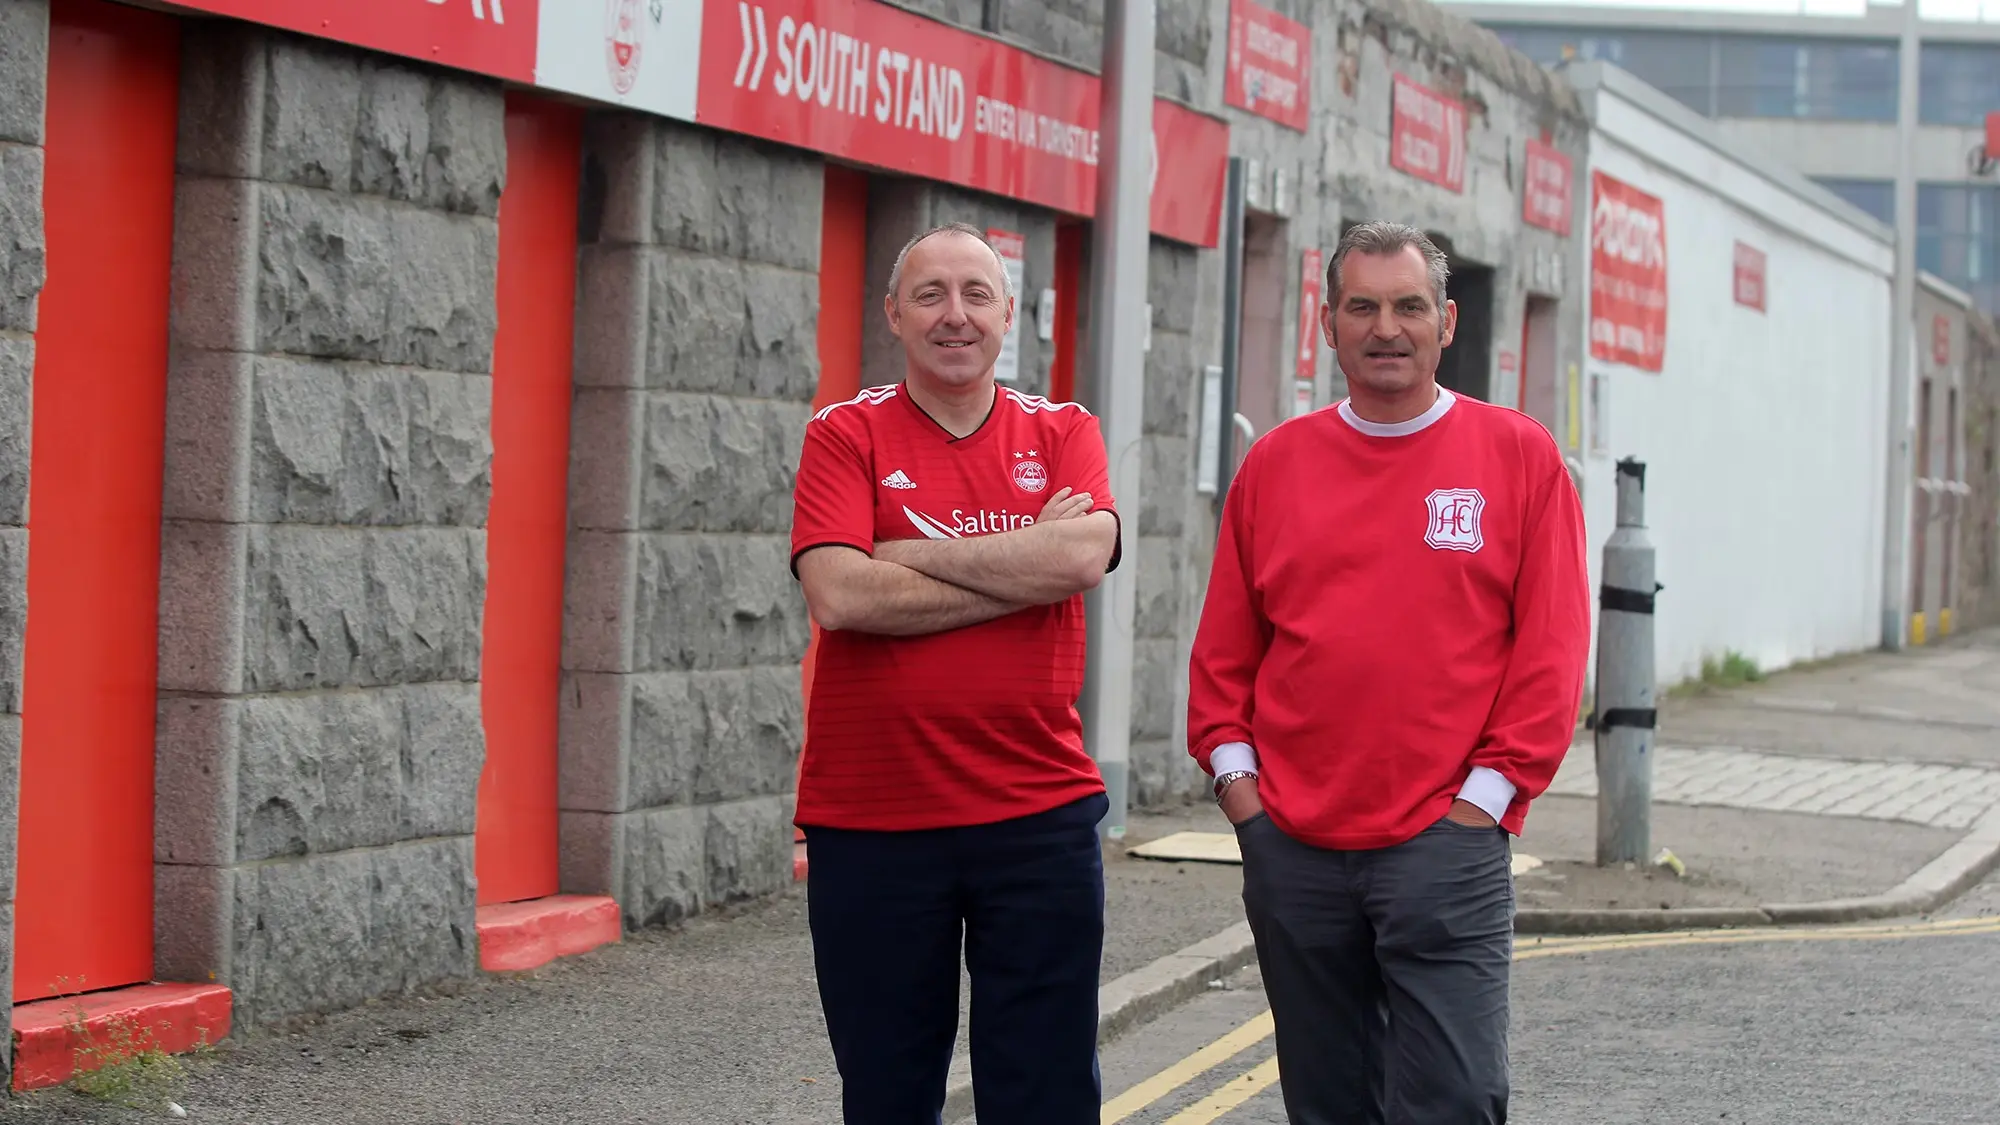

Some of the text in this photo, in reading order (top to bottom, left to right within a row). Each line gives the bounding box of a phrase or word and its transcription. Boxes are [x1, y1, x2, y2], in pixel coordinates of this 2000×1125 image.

[774, 15, 870, 117] SOUTH
[874, 47, 965, 141] STAND
[975, 95, 1016, 144] ENTER
[1018, 107, 1036, 148] VIA
[881, 479, 917, 490] adidas
[952, 509, 1034, 534] Saltire
